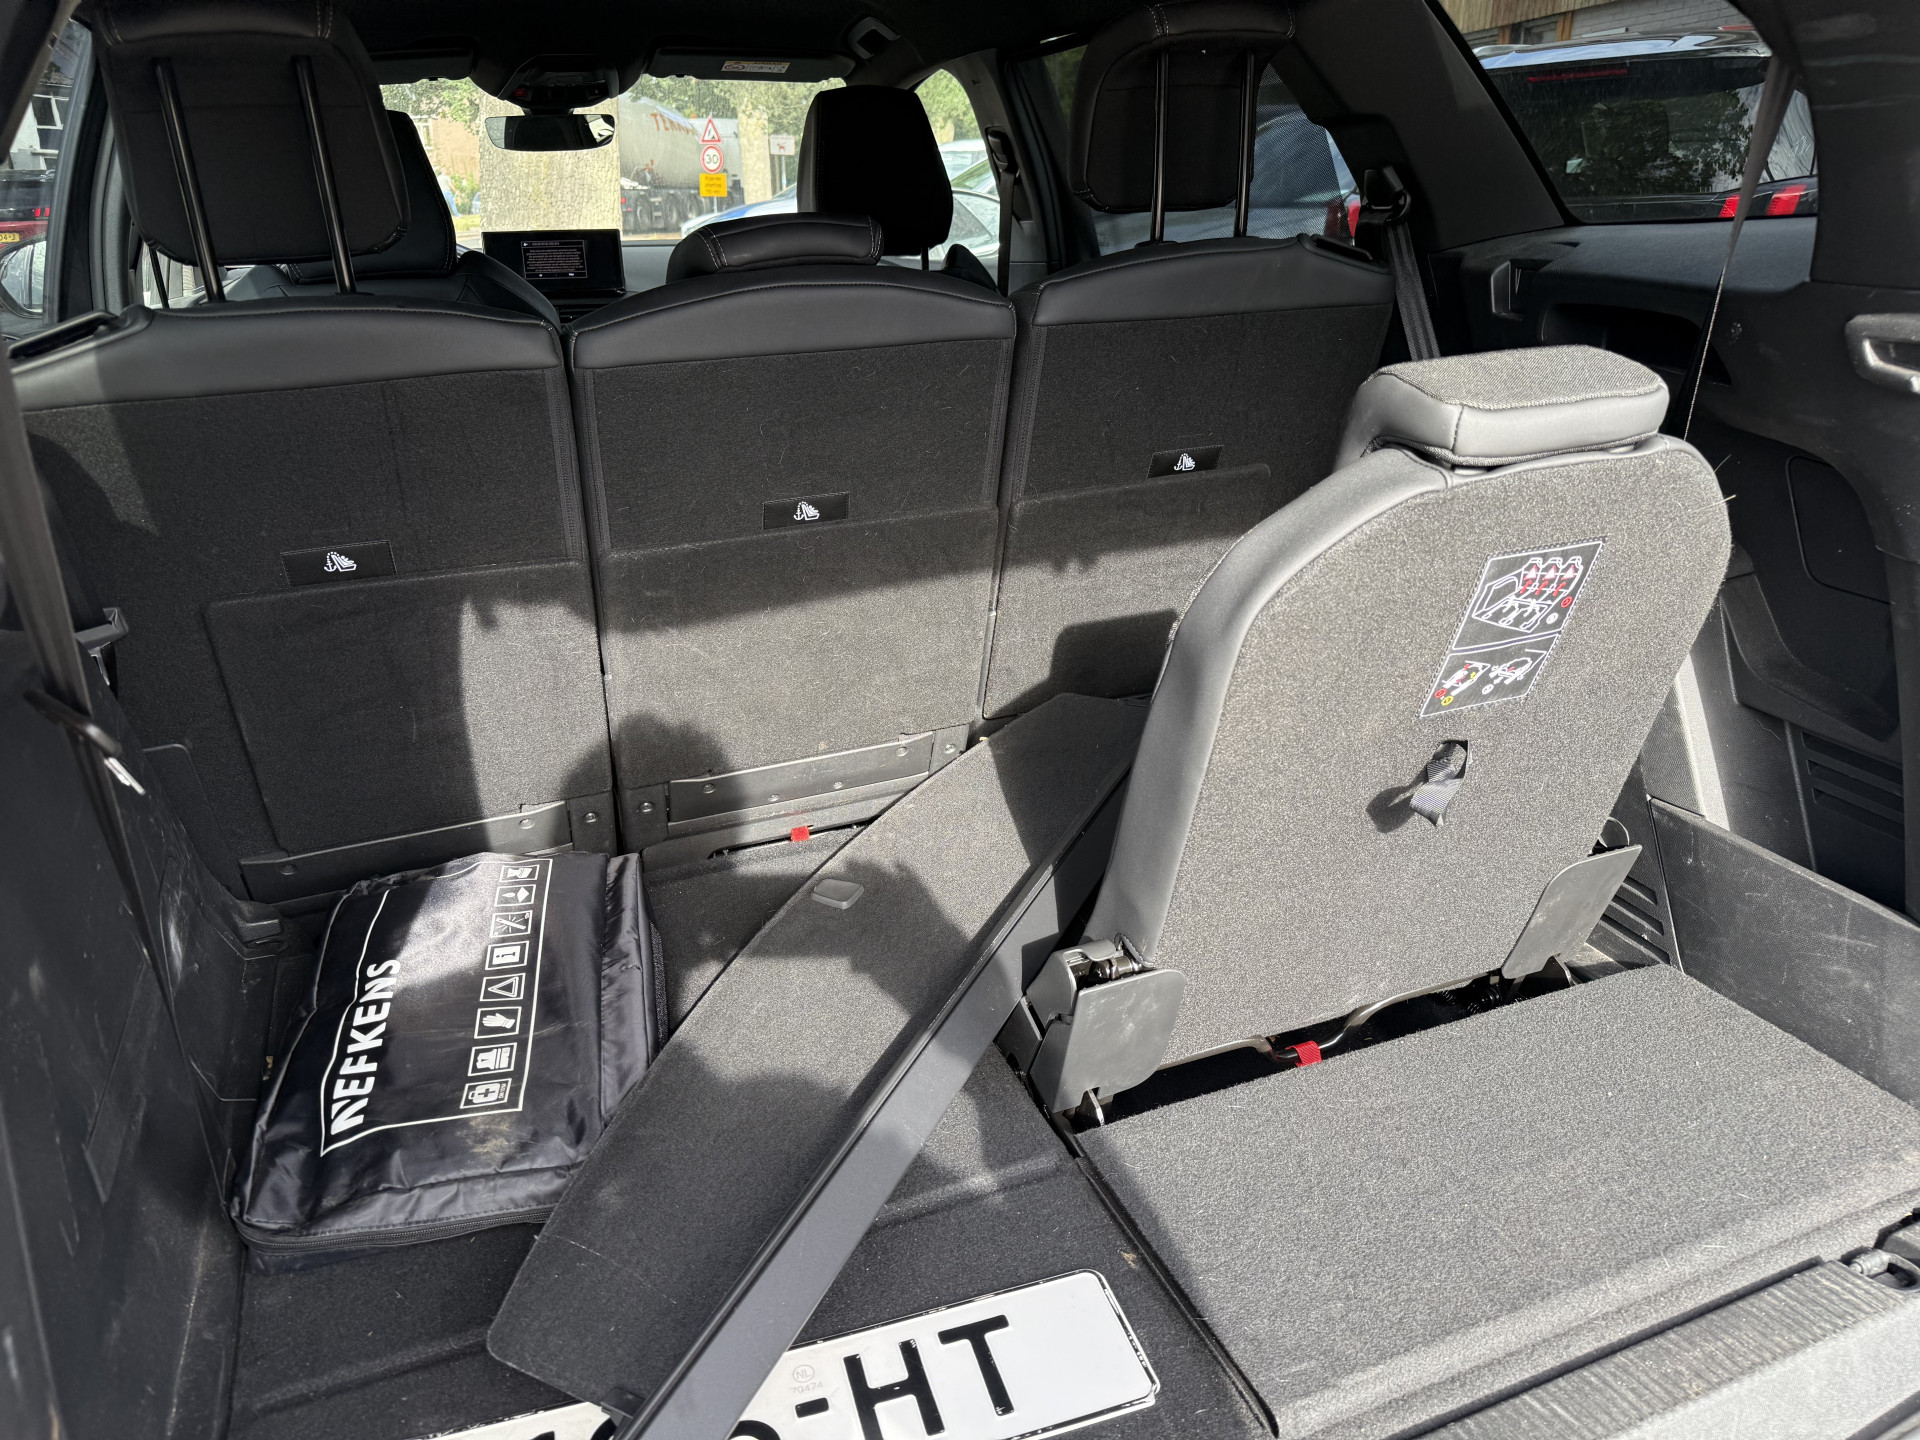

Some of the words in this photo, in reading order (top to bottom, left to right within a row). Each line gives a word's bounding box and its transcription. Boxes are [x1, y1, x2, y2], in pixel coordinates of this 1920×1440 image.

[706, 154, 719, 164] 30
[331, 959, 402, 1135] NEFKENS
[796, 1368, 812, 1380] NL
